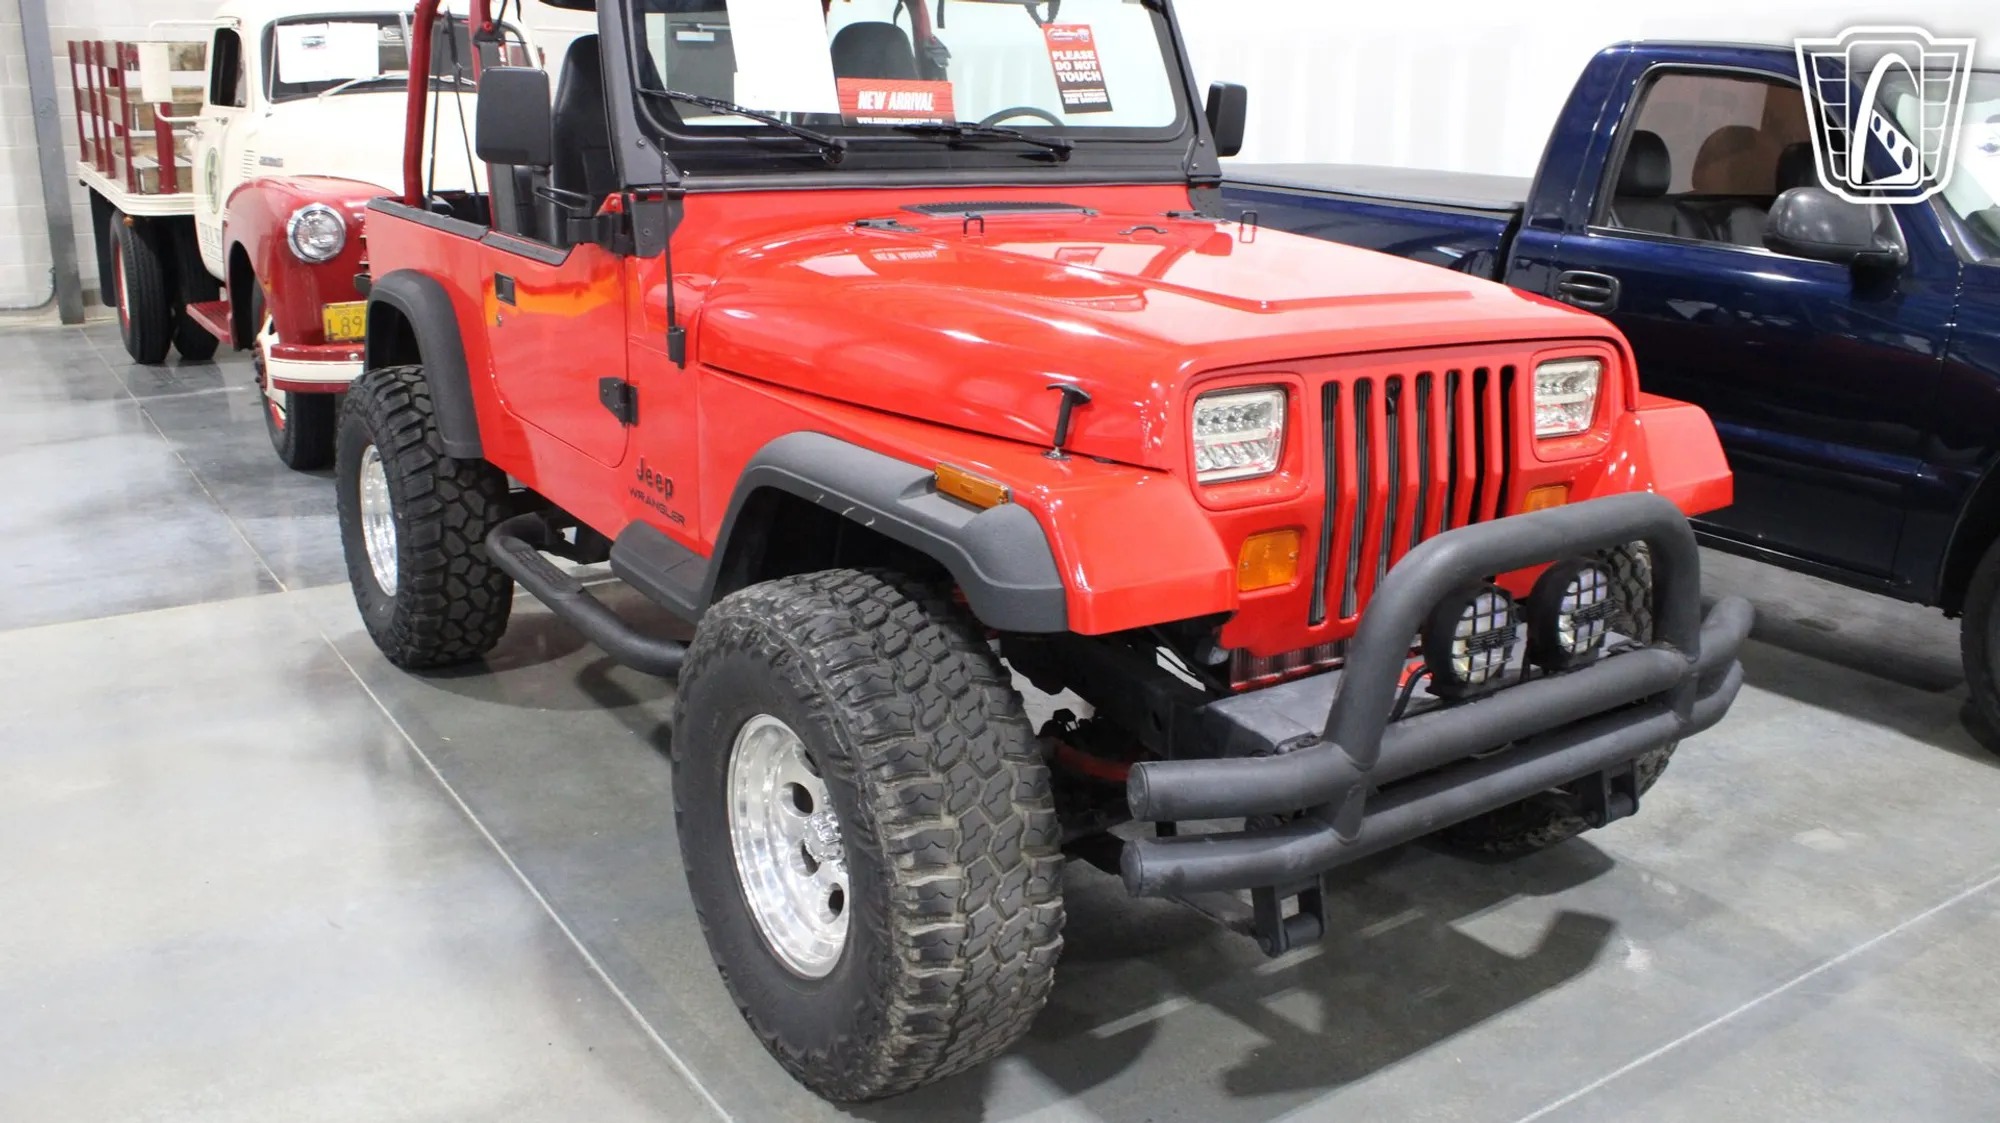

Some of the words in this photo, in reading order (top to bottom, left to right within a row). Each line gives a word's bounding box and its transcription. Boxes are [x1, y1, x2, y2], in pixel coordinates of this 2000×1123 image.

[1051, 50, 1095, 60] PLEASE
[1054, 61, 1072, 71] DO
[1073, 60, 1097, 70] NOT
[1057, 71, 1102, 82] TOUCH
[857, 90, 887, 110] NEW
[887, 91, 935, 111] ARRIVAL
[636, 456, 674, 500] Jeep
[627, 486, 686, 527] WRANGLER
